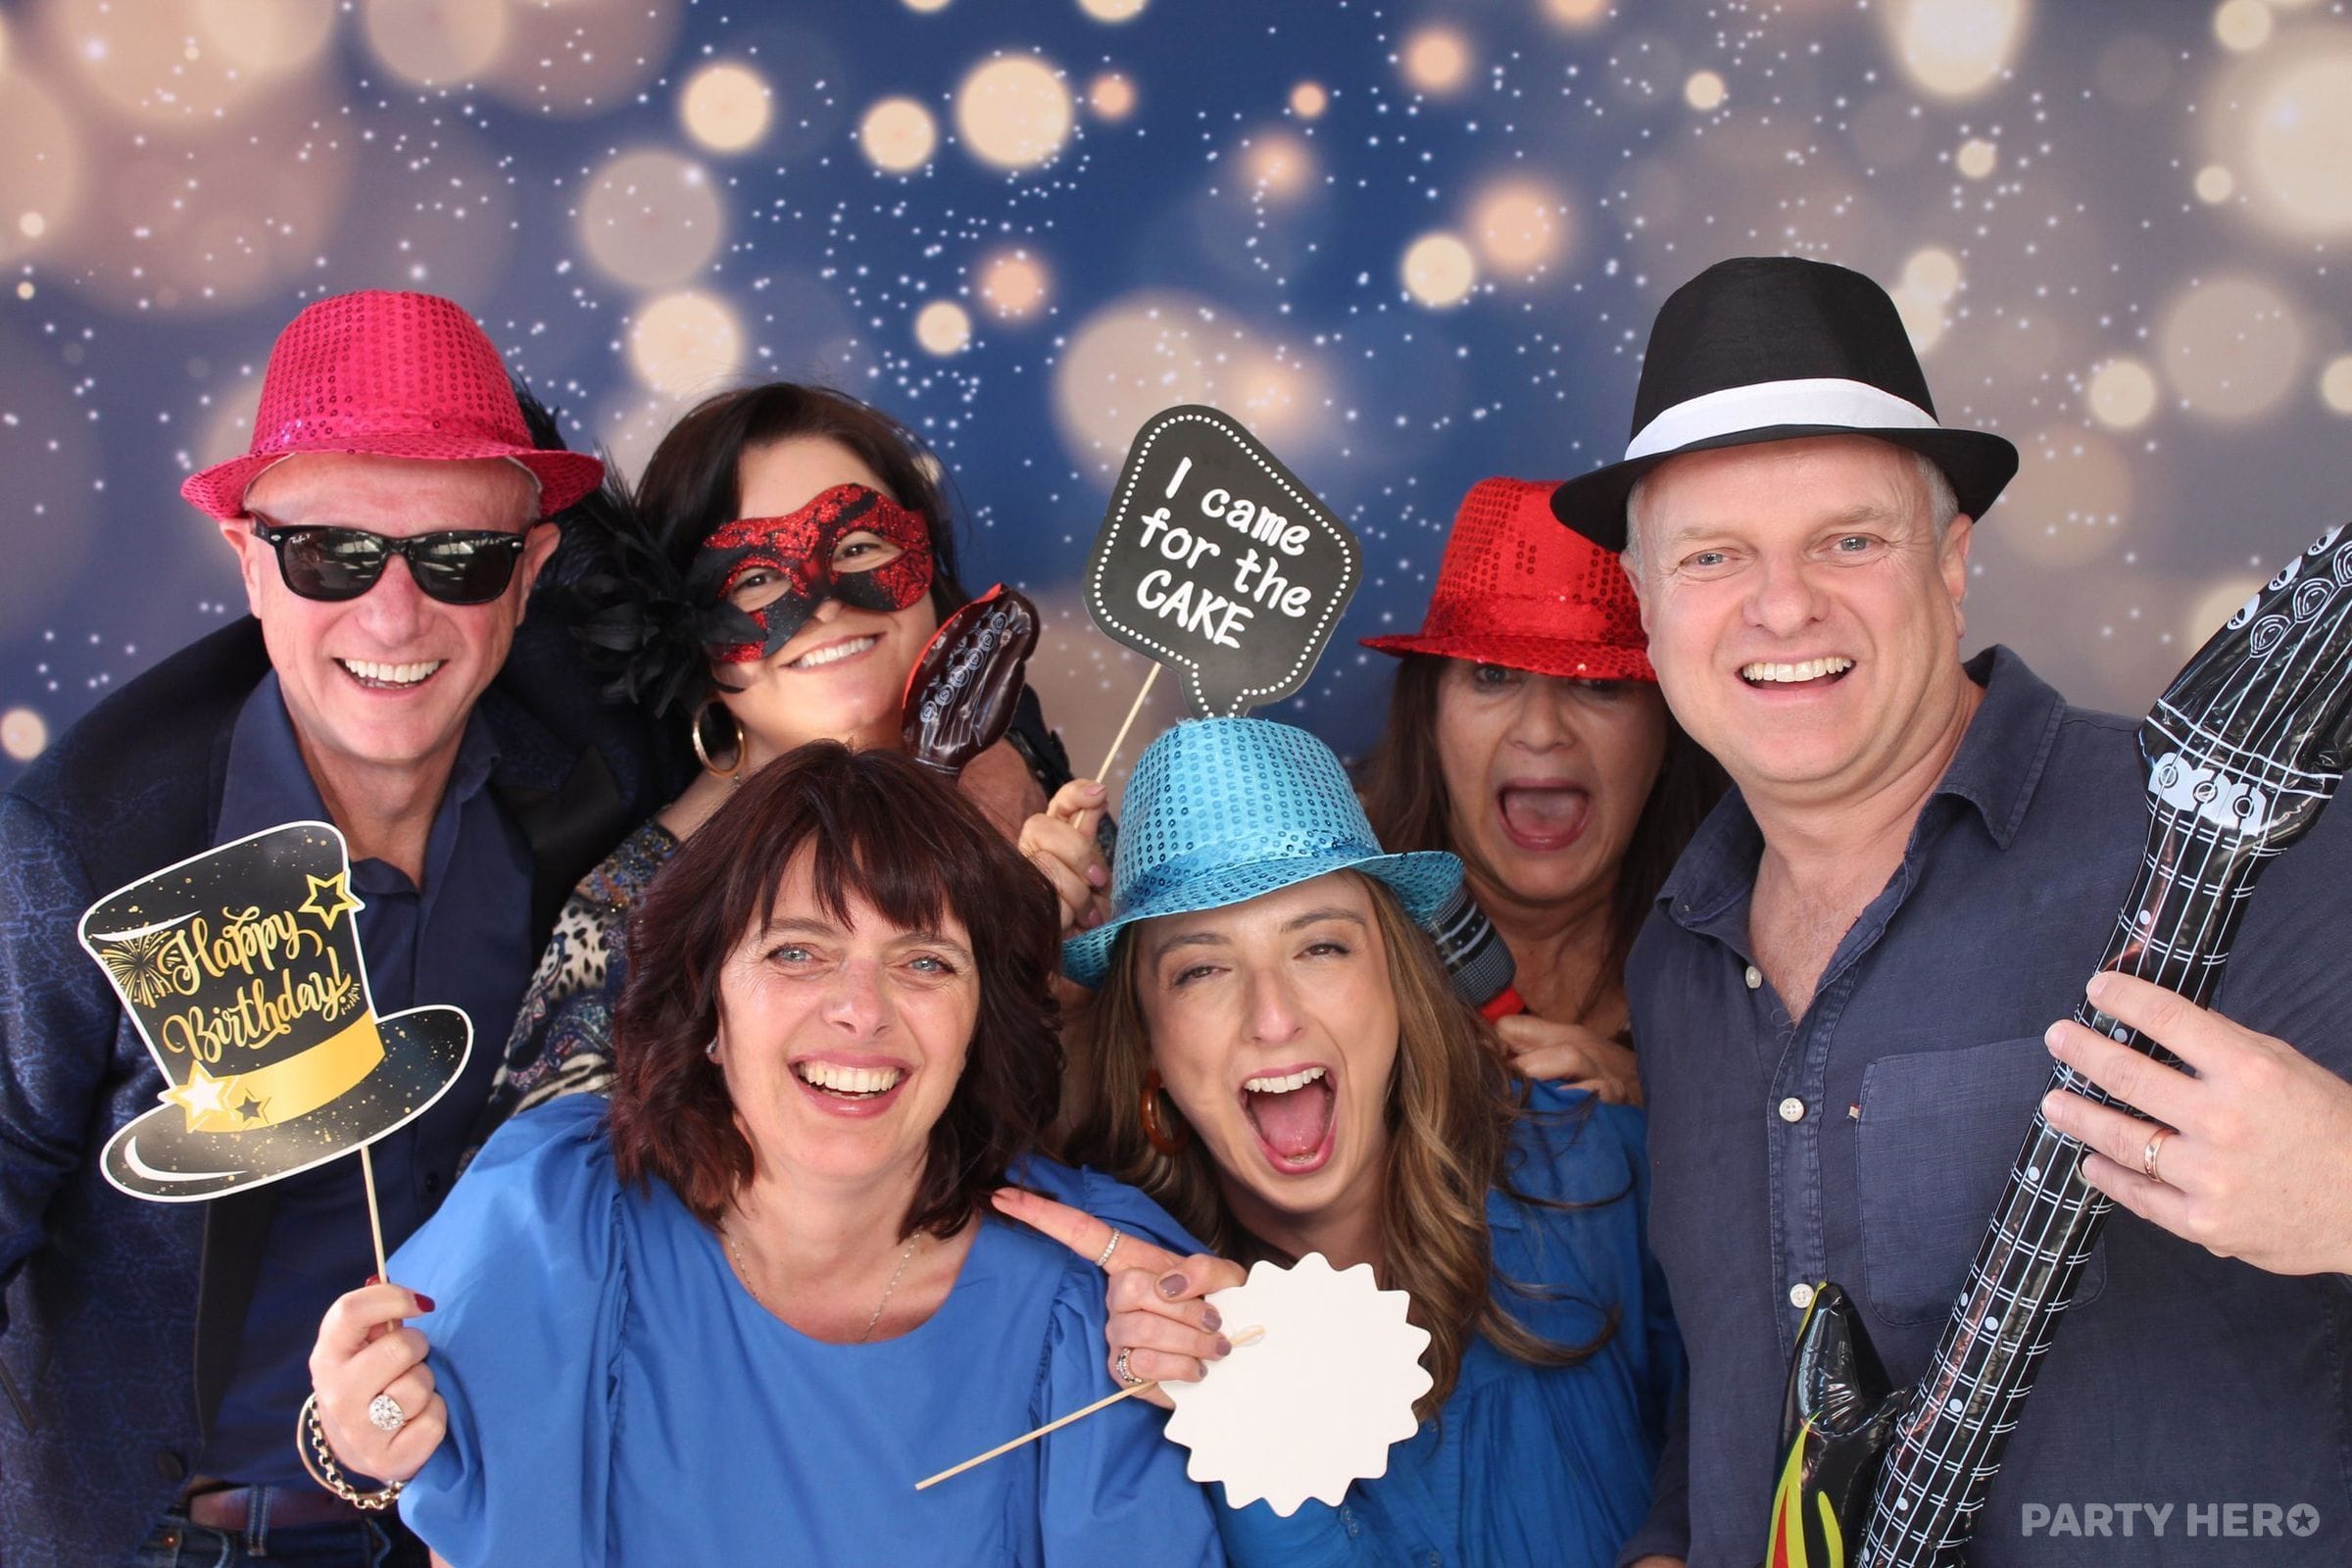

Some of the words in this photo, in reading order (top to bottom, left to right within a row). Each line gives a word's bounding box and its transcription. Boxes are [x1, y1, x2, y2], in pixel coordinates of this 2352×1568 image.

[1166, 457, 1192, 499] I
[1200, 489, 1310, 556] came
[1138, 569, 1254, 649] CAKE
[1141, 508, 1220, 568] for
[1235, 548, 1311, 617] the
[157, 906, 322, 996] Happy
[163, 947, 351, 1063] Birthday!
